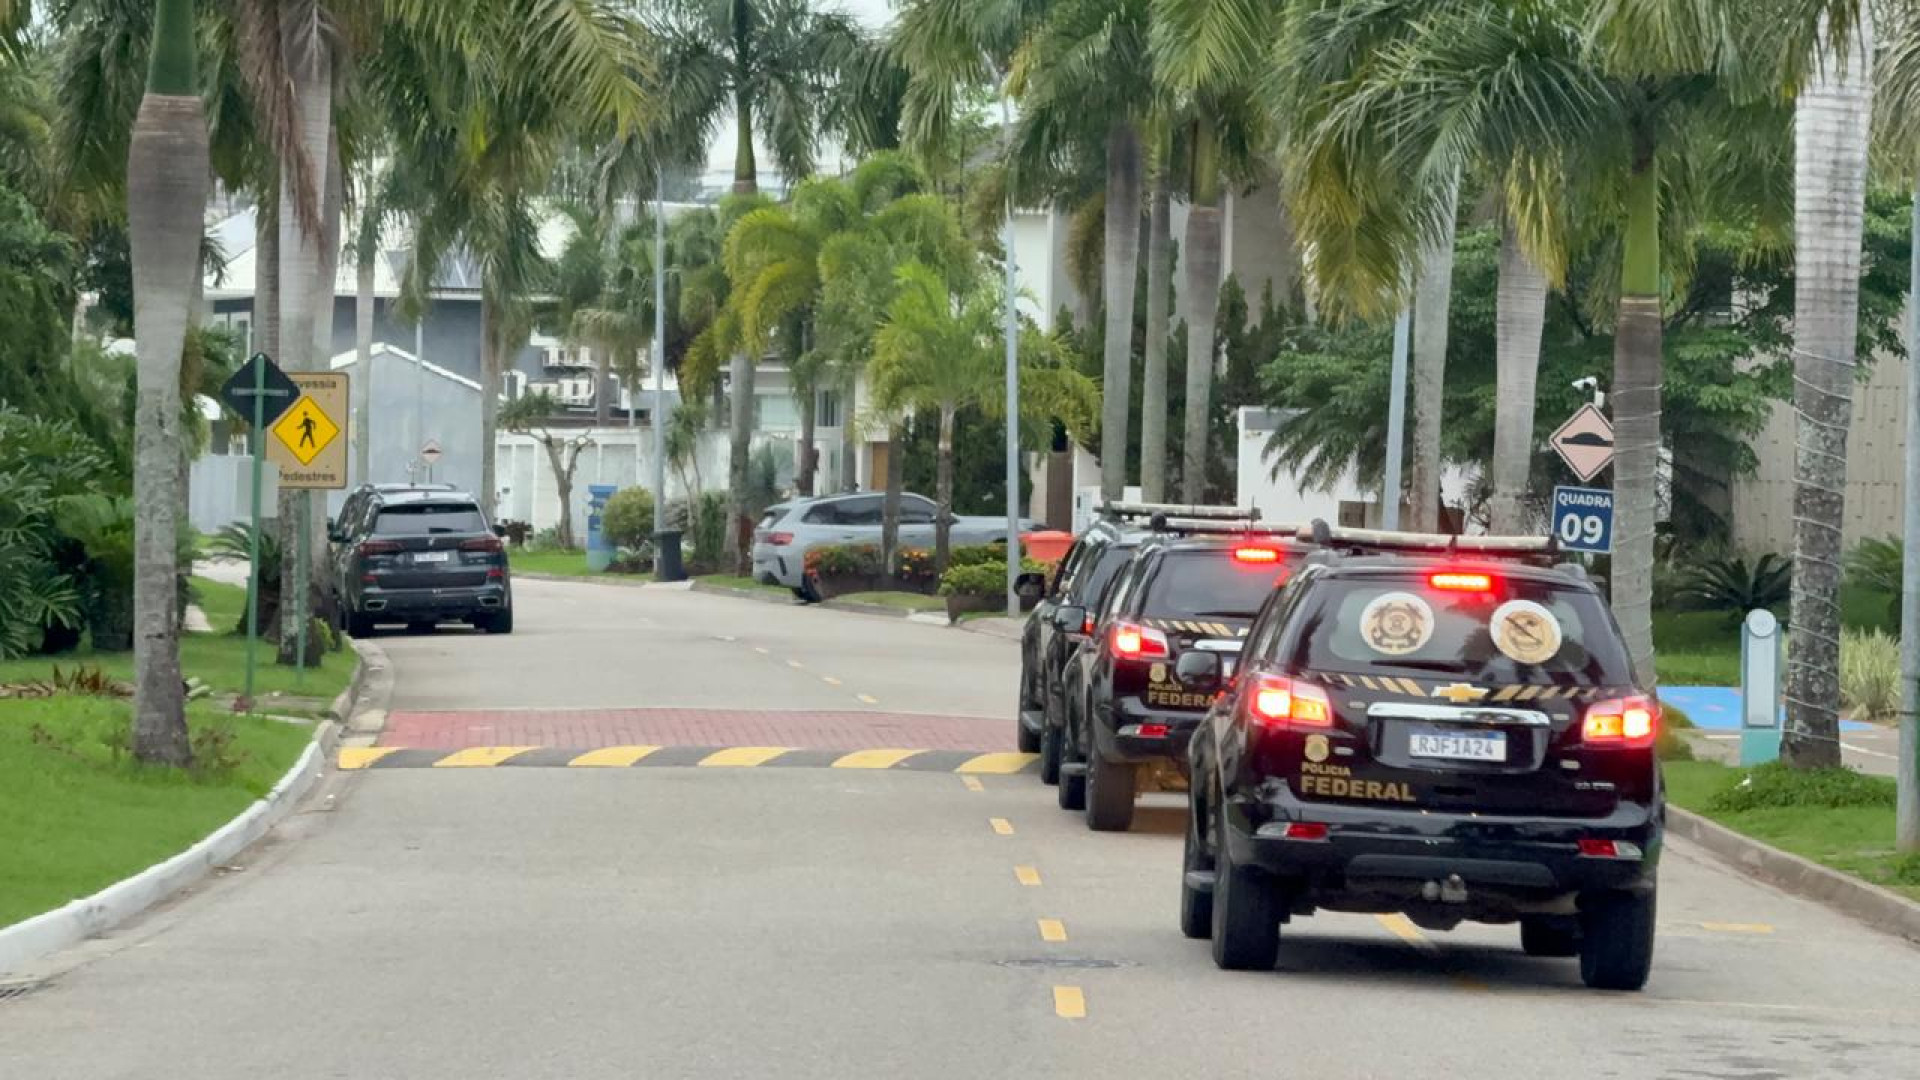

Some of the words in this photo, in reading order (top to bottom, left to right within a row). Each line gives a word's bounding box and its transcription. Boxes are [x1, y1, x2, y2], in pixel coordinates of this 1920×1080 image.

[298, 381, 337, 389] vessia
[1558, 491, 1612, 508] QUADRA
[1560, 512, 1603, 544] 09
[1148, 691, 1214, 706] FEDERA
[1418, 734, 1494, 757] RJF1A24
[1301, 776, 1417, 801] FEDERAL
